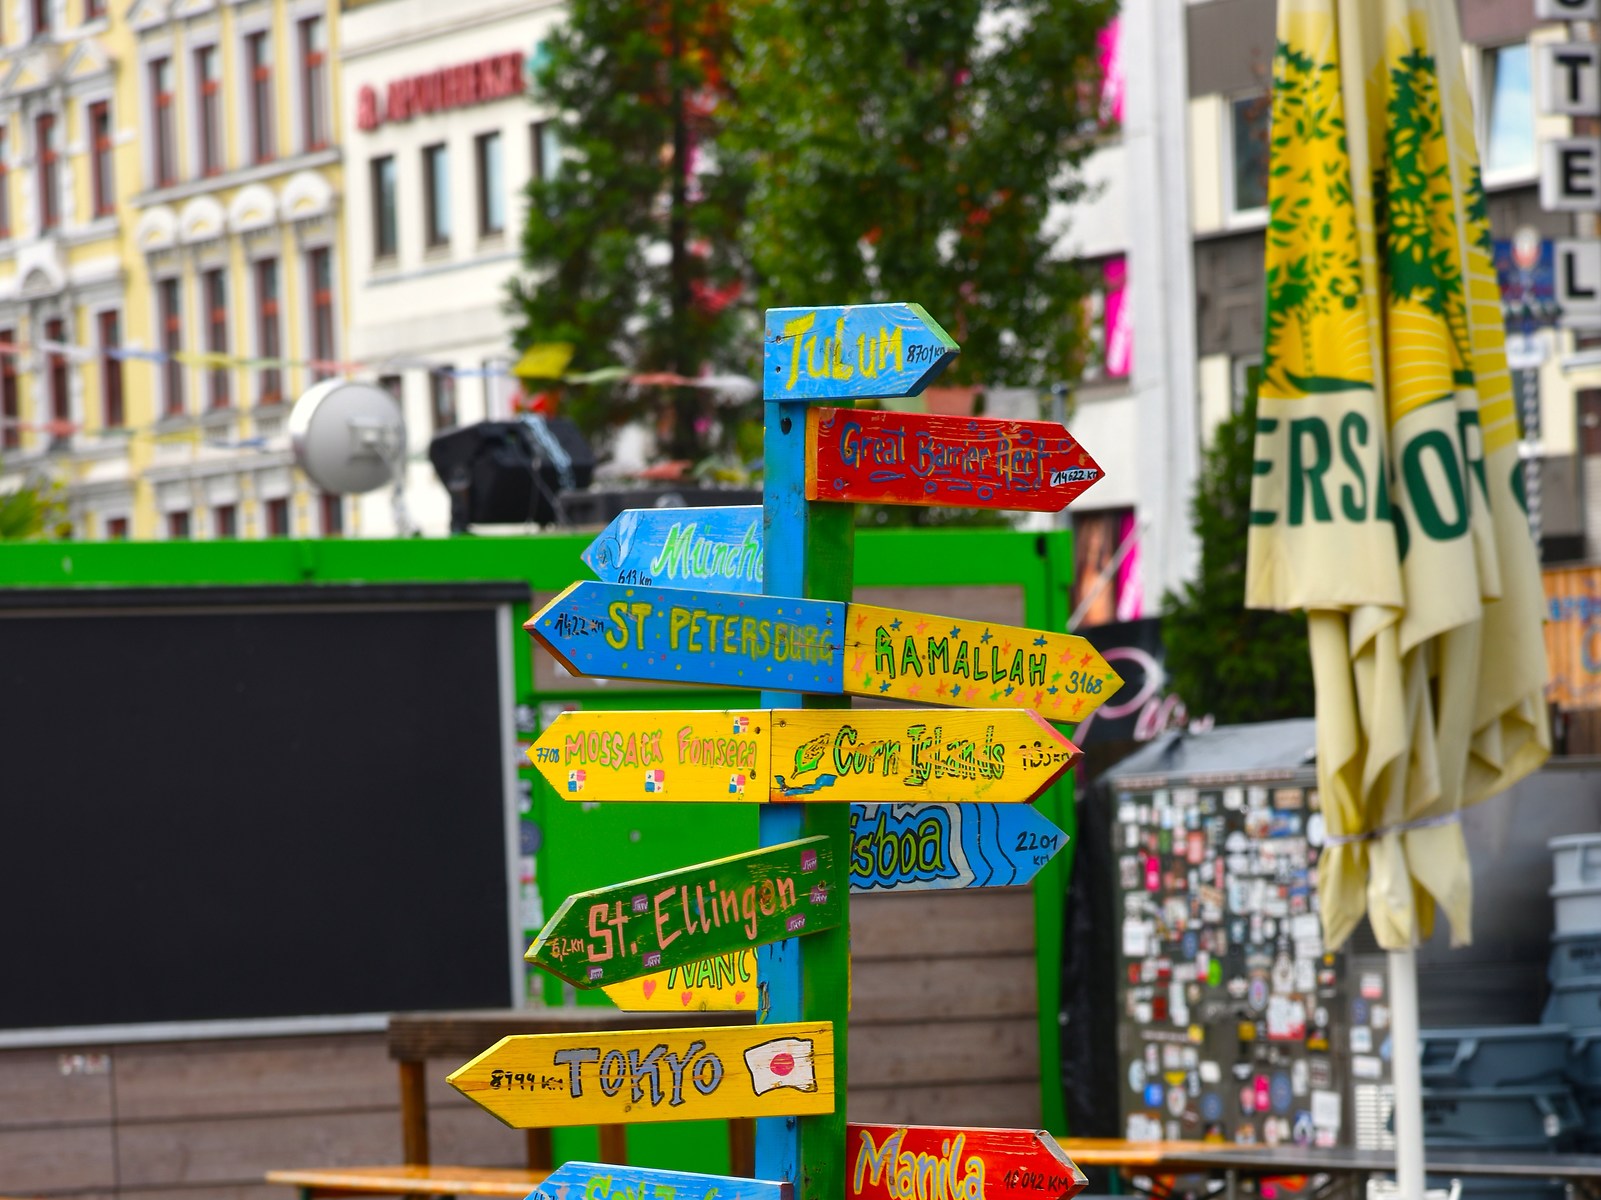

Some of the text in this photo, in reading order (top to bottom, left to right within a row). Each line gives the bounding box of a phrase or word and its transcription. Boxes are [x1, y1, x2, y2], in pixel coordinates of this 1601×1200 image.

[1553, 0, 1597, 299] TEL
[840, 421, 1051, 490] Great Barrier Reef
[1053, 470, 1085, 484] 14622
[618, 569, 637, 585] 613
[554, 613, 589, 637] 1422
[605, 601, 834, 666] ST PETERSBURG
[875, 626, 1046, 686] RAMALLAH
[1065, 671, 1103, 694] 3168
[565, 726, 757, 771] MOSSACK Fonseca
[833, 725, 900, 777] Corn
[1014, 831, 1058, 852] 2201
[587, 877, 797, 962] St. Ellingen
[553, 1039, 725, 1107] TOKYO
